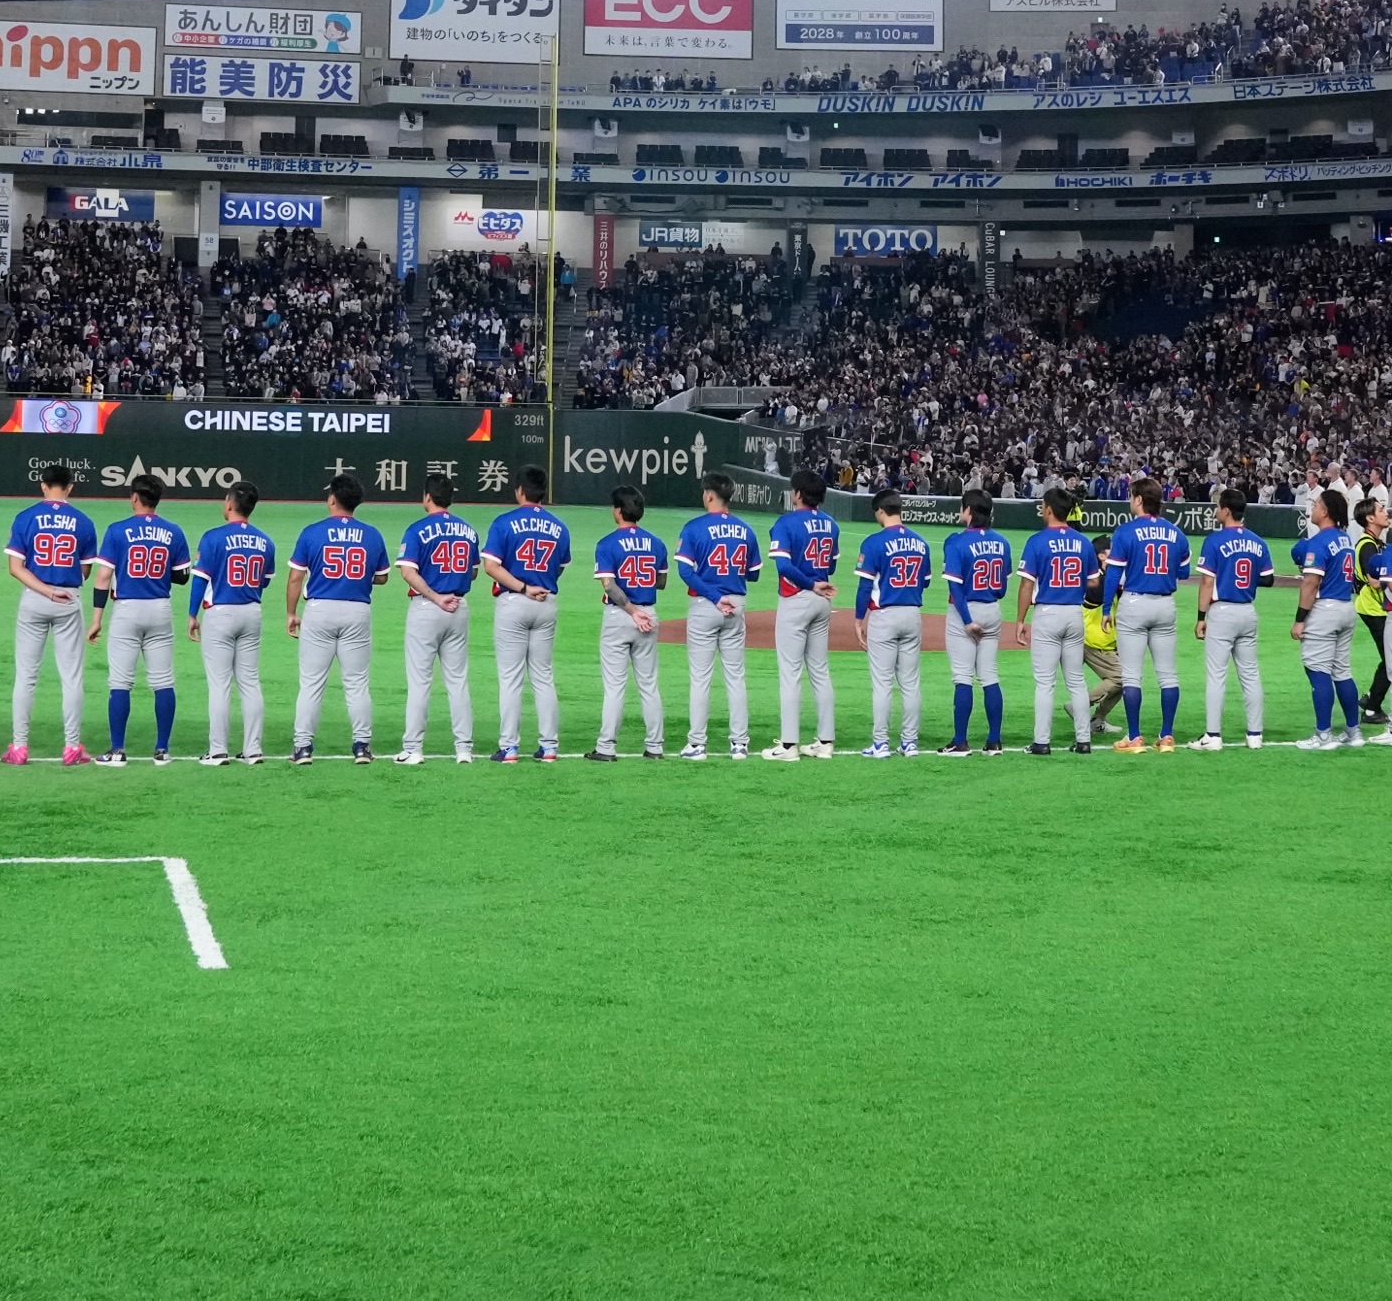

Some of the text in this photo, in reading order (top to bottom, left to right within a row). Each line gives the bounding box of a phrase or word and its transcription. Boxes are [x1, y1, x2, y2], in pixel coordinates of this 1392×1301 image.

[178, 8, 314, 36] あんしん財団
[89, 76, 141, 90] ニップン
[170, 57, 353, 100] 能美防災
[1233, 76, 1376, 99] 日本ステージ株式会社
[1066, 176, 1133, 188] HOCHIKI
[74, 196, 130, 212] GALA
[224, 199, 314, 221] SAISON
[642, 227, 700, 245] JR貨物
[839, 228, 934, 251] TOTO
[184, 409, 390, 434] CHINESE TAIPEI
[514, 414, 545, 426] 329ft
[521, 434, 545, 443] 100m
[100, 454, 242, 488] SANKYO
[564, 435, 690, 485] kewpie
[35, 514, 77, 532] T.C.SHA
[125, 525, 173, 546] C.J.SUNG
[327, 528, 363, 543] C.W.HU
[510, 517, 562, 539] H.C.CHENG
[1165, 508, 1223, 532] ンボ鉛
[33, 532, 77, 567] 92
[127, 544, 169, 579] 88
[322, 546, 367, 580] 58
[430, 540, 470, 574] 48
[516, 538, 557, 572] 47
[708, 544, 748, 575] 44
[804, 537, 833, 569] 42
[1144, 543, 1169, 575] 11
[227, 553, 265, 588] 60
[617, 555, 656, 588] 45
[888, 556, 923, 588] 37
[972, 558, 1004, 591] 20
[1049, 556, 1082, 588] 12
[1235, 557, 1252, 589] 9
[1342, 552, 1354, 583] 4
